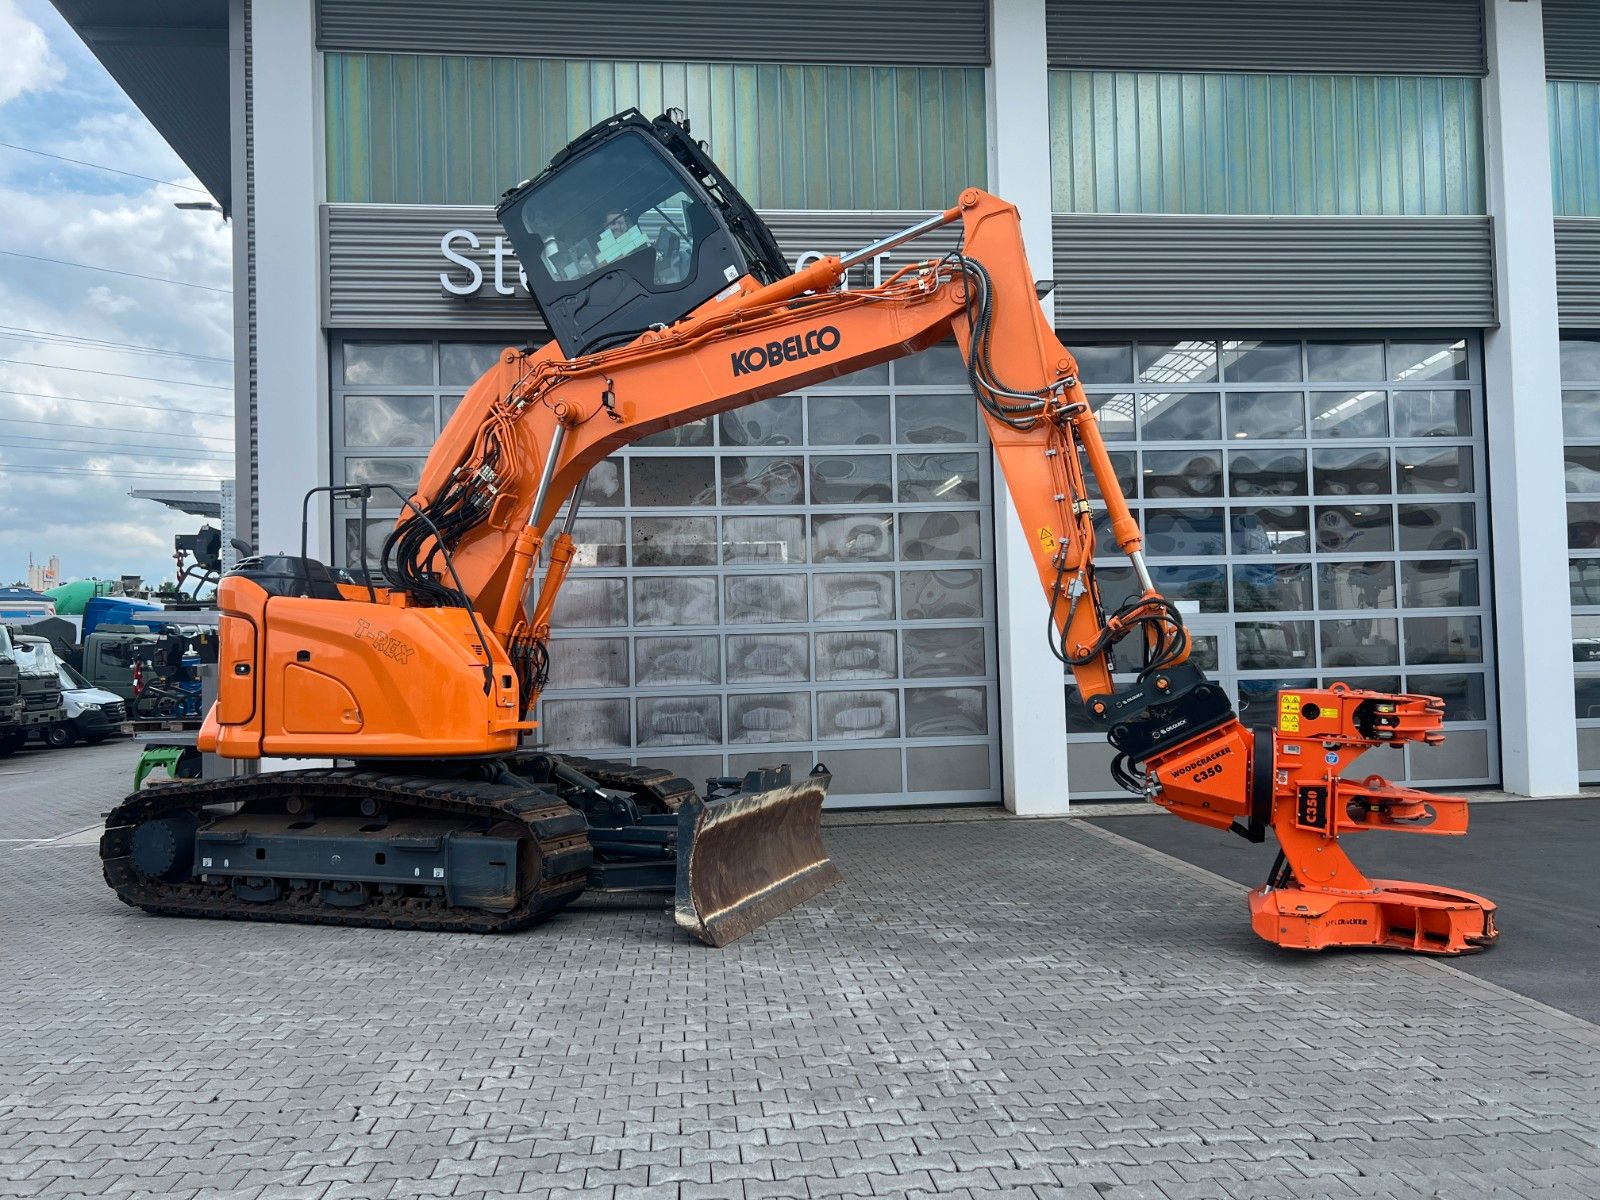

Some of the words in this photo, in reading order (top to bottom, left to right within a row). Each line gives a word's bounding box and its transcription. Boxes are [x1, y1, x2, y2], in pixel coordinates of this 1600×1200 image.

[731, 326, 841, 377] KOBELCO
[355, 618, 415, 664] T-REX
[1171, 747, 1232, 778] WOODCRACKER
[1193, 764, 1223, 783] C350
[1306, 790, 1318, 823] C350
